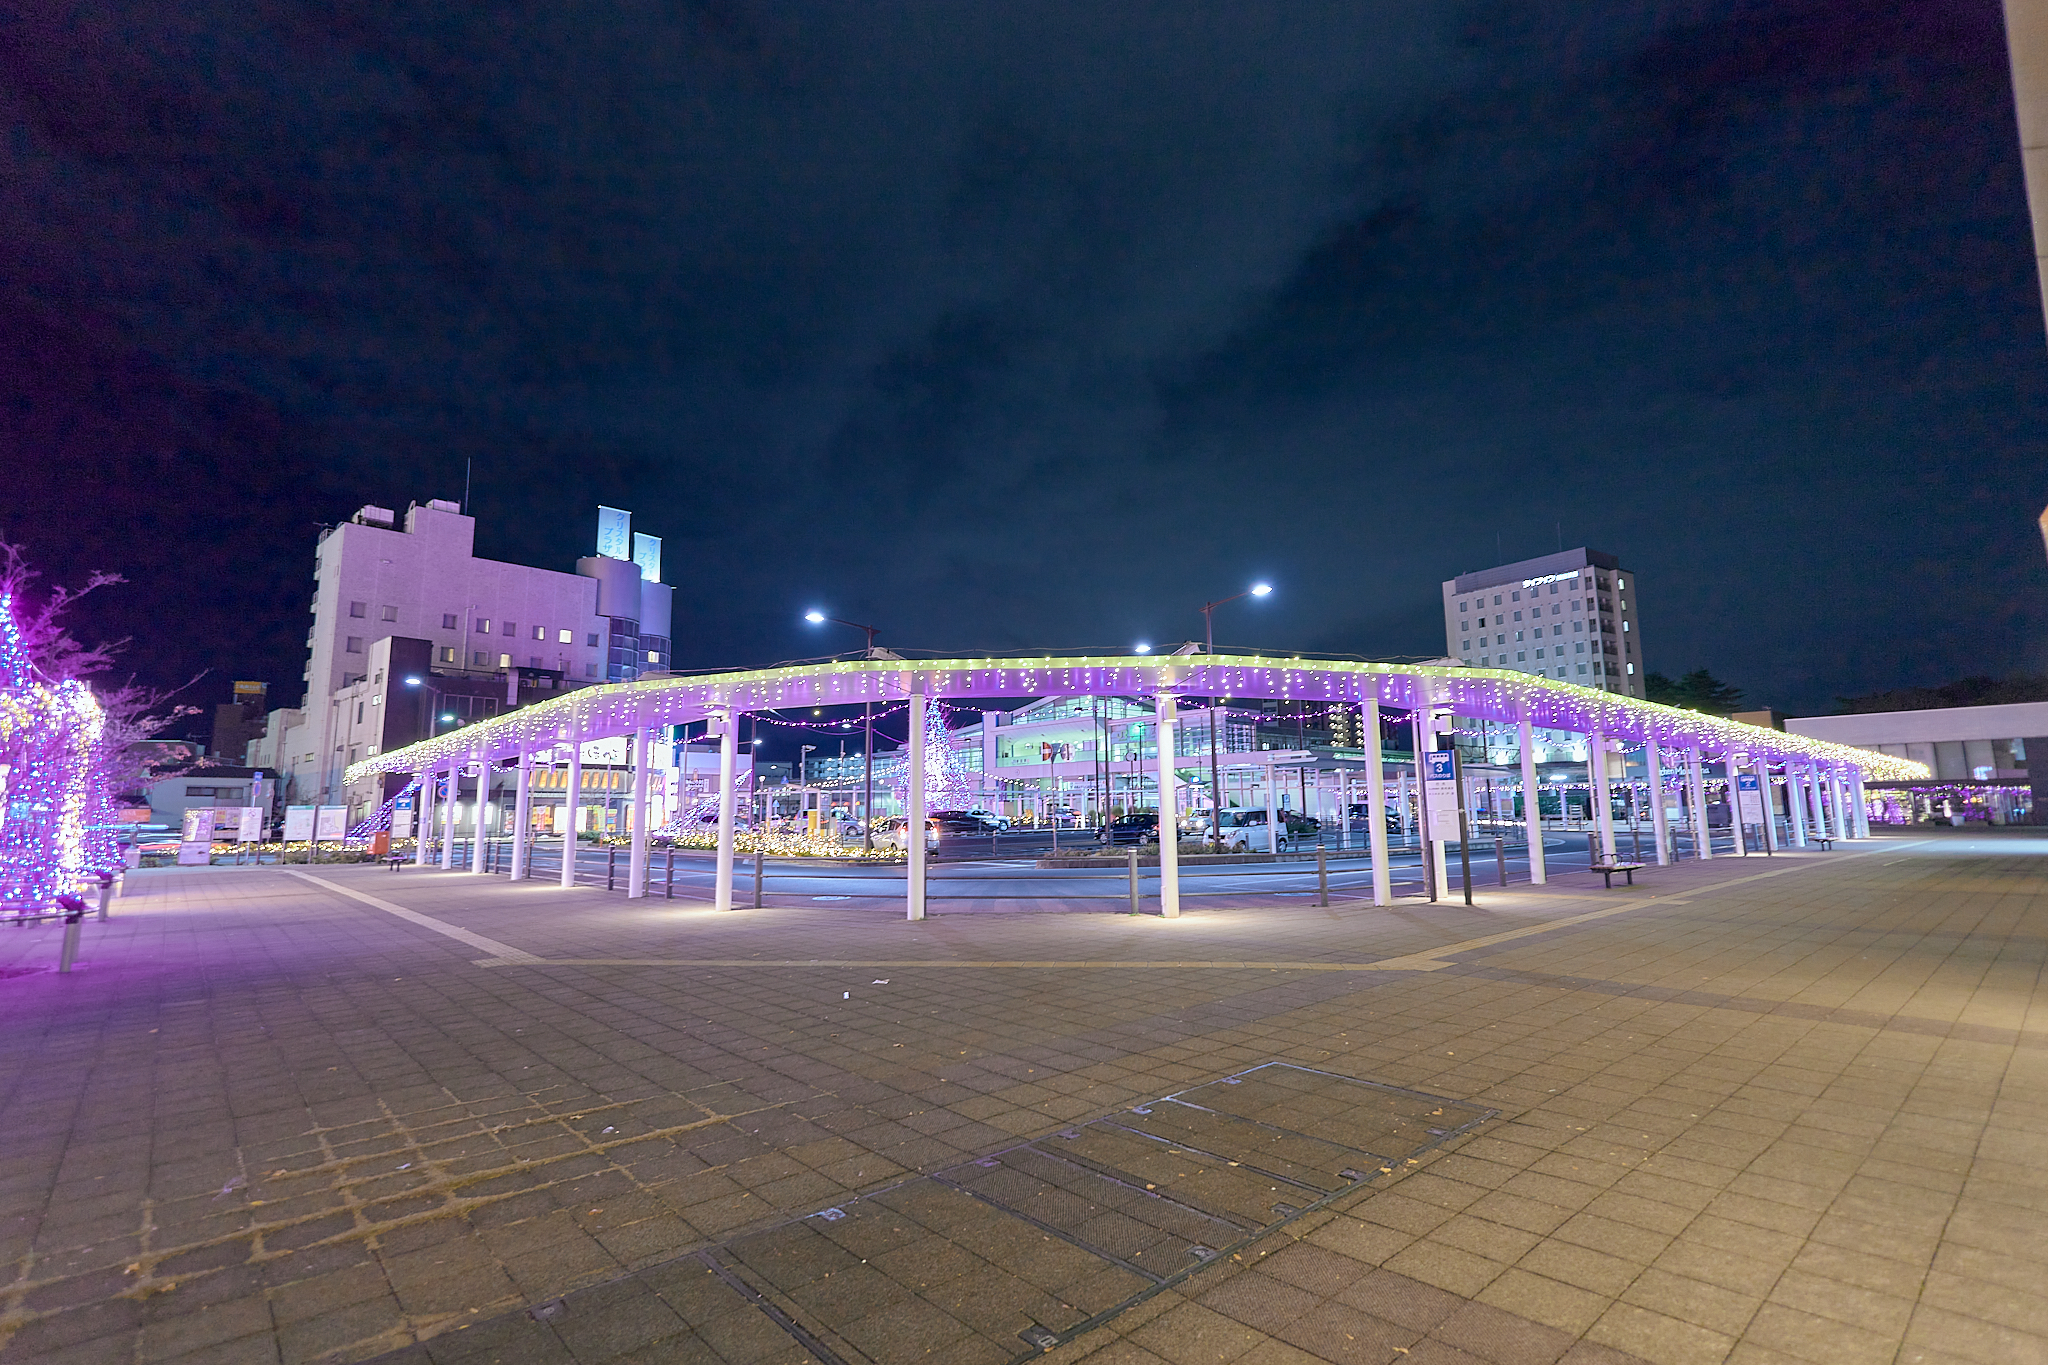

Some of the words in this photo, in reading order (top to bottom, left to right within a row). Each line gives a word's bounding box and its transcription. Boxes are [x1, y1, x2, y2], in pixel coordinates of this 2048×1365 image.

[603, 527, 614, 553] プラザ
[616, 512, 625, 554] クリスタル
[1436, 763, 1443, 772] 3
